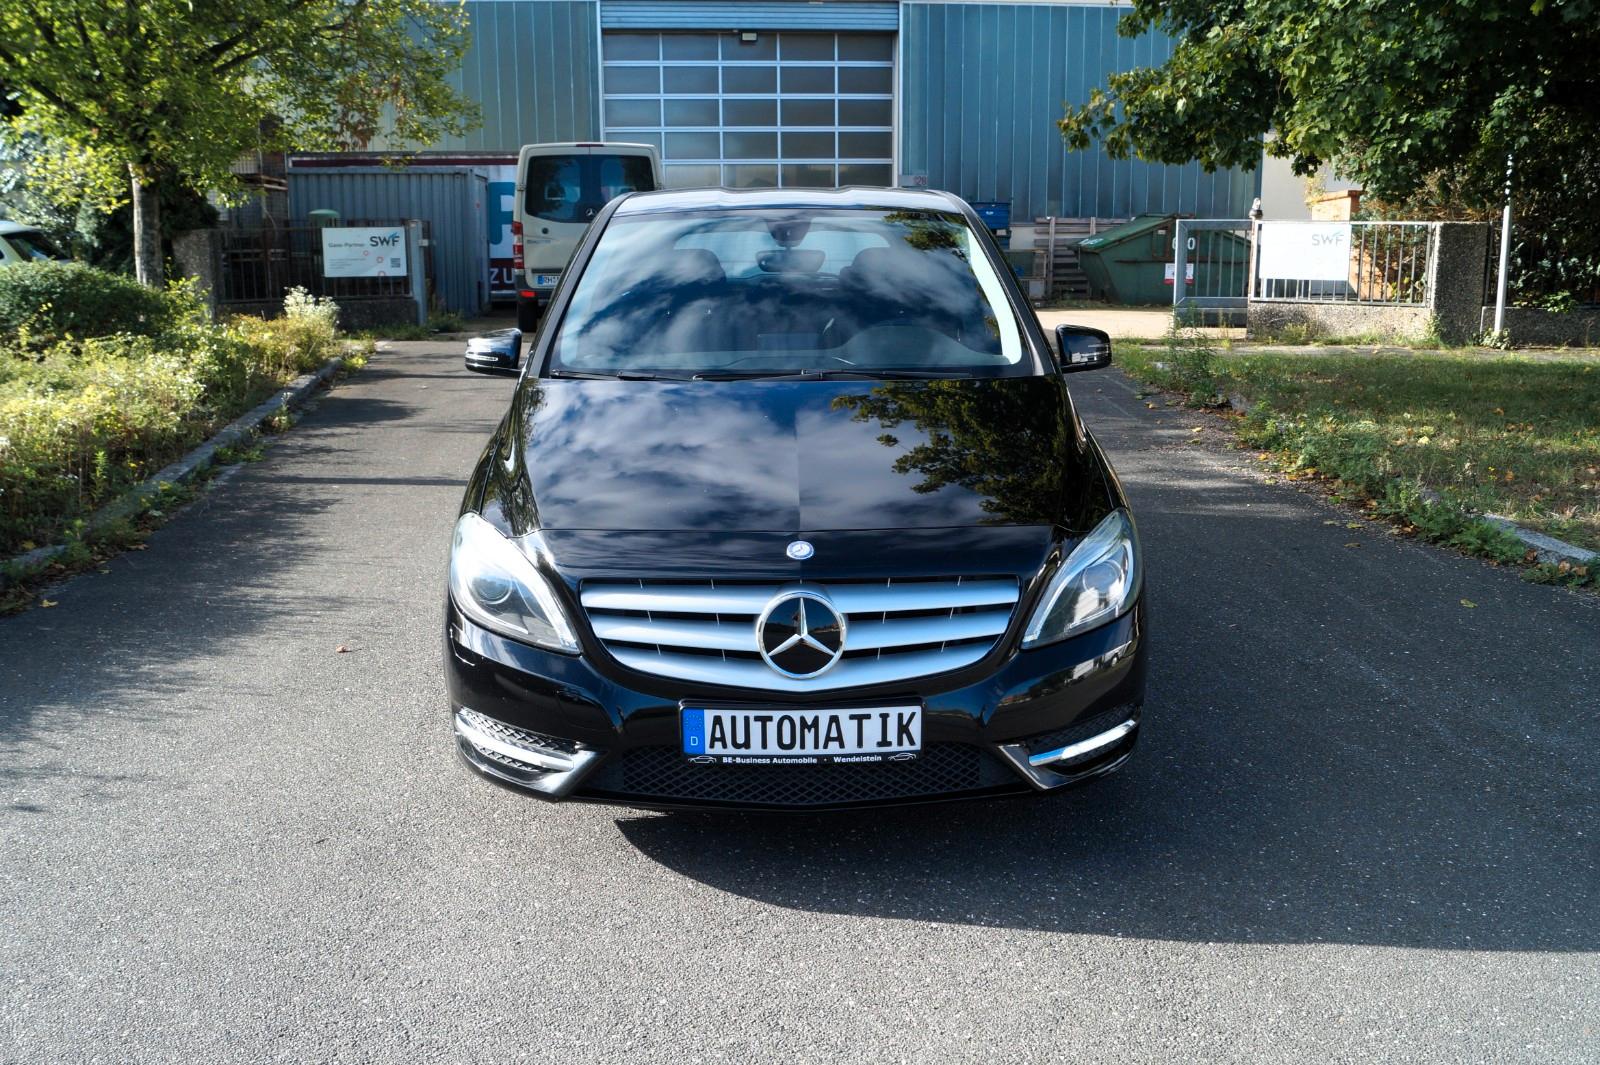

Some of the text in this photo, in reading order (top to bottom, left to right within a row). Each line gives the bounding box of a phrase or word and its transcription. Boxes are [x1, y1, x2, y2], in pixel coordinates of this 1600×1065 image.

[369, 232, 400, 247] SWF
[1311, 230, 1345, 247] SWF
[708, 711, 917, 750] AUTOMATIK
[690, 736, 698, 746] D
[722, 754, 882, 764] BE-Business Automobile Wendelstein
